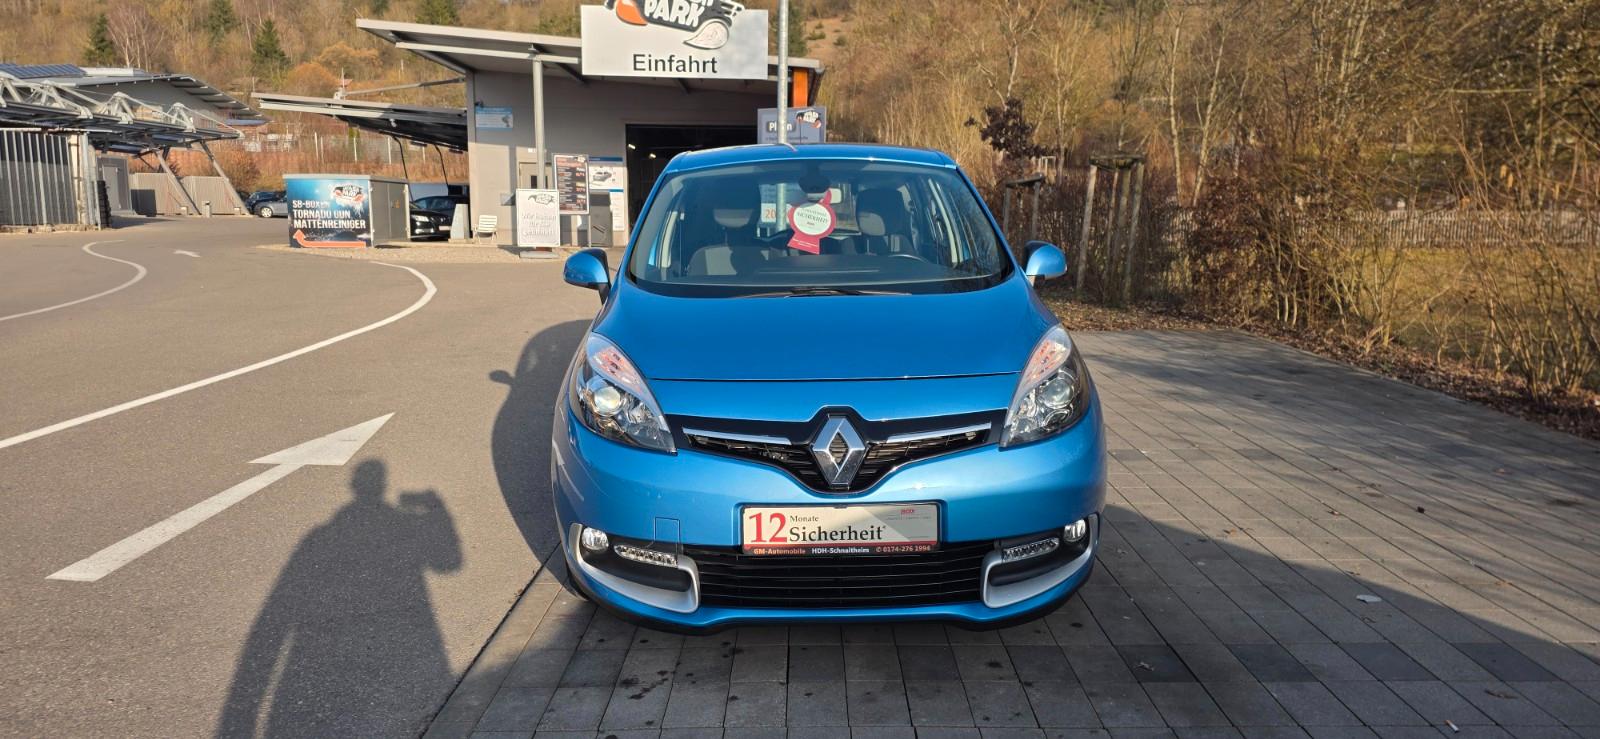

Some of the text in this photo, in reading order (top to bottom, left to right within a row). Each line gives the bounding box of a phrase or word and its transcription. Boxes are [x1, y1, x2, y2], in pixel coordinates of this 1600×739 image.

[644, 0, 705, 27] PARK
[633, 54, 718, 74] Einfahrt
[293, 209, 332, 219] TORNADO
[294, 219, 366, 229] MATTENREINIGER
[748, 512, 788, 543] 12
